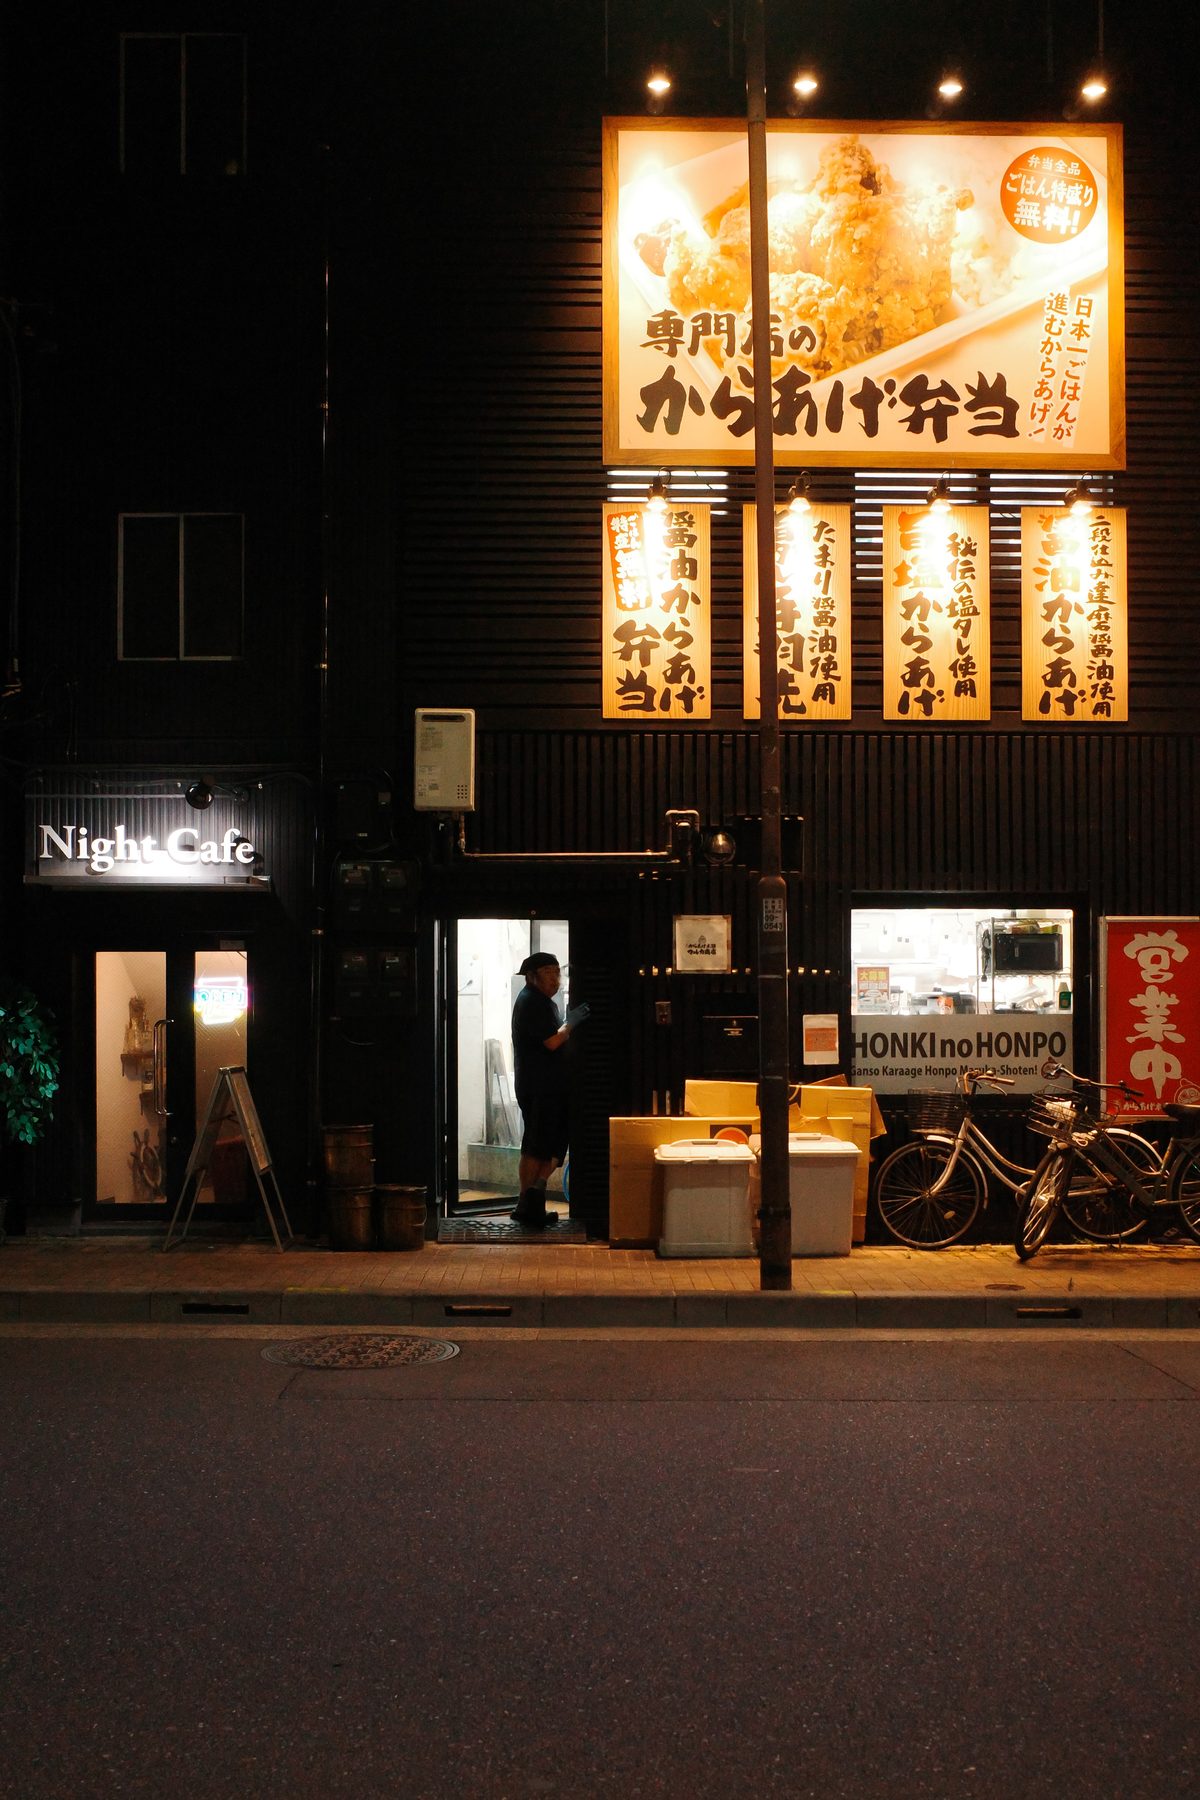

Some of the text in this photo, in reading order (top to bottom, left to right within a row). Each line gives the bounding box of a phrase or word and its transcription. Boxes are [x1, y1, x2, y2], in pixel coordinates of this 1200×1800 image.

[1006, 172, 1095, 208] ごはん特盛り
[1027, 154, 1081, 176] 弁当全品
[1013, 197, 1081, 235] 無料!
[639, 311, 817, 358] 専門店の
[1028, 292, 1069, 438] 進むからあげ!
[1052, 296, 1094, 440] 日本一ごはんが
[635, 364, 1021, 444] からあげ弁当
[659, 511, 705, 714] 醤油からあげ
[808, 520, 842, 705] たまり醤油使用
[946, 532, 981, 699] 秘伝の塩タレ使用
[1032, 514, 1087, 717] 醤油からあげ
[612, 619, 662, 713] 弁当
[39, 824, 255, 872] Night Cafe
[1122, 929, 1191, 1100] 営業中
[882, 1065, 923, 1079] Karaage
[925, 1065, 957, 1078] Honpo
